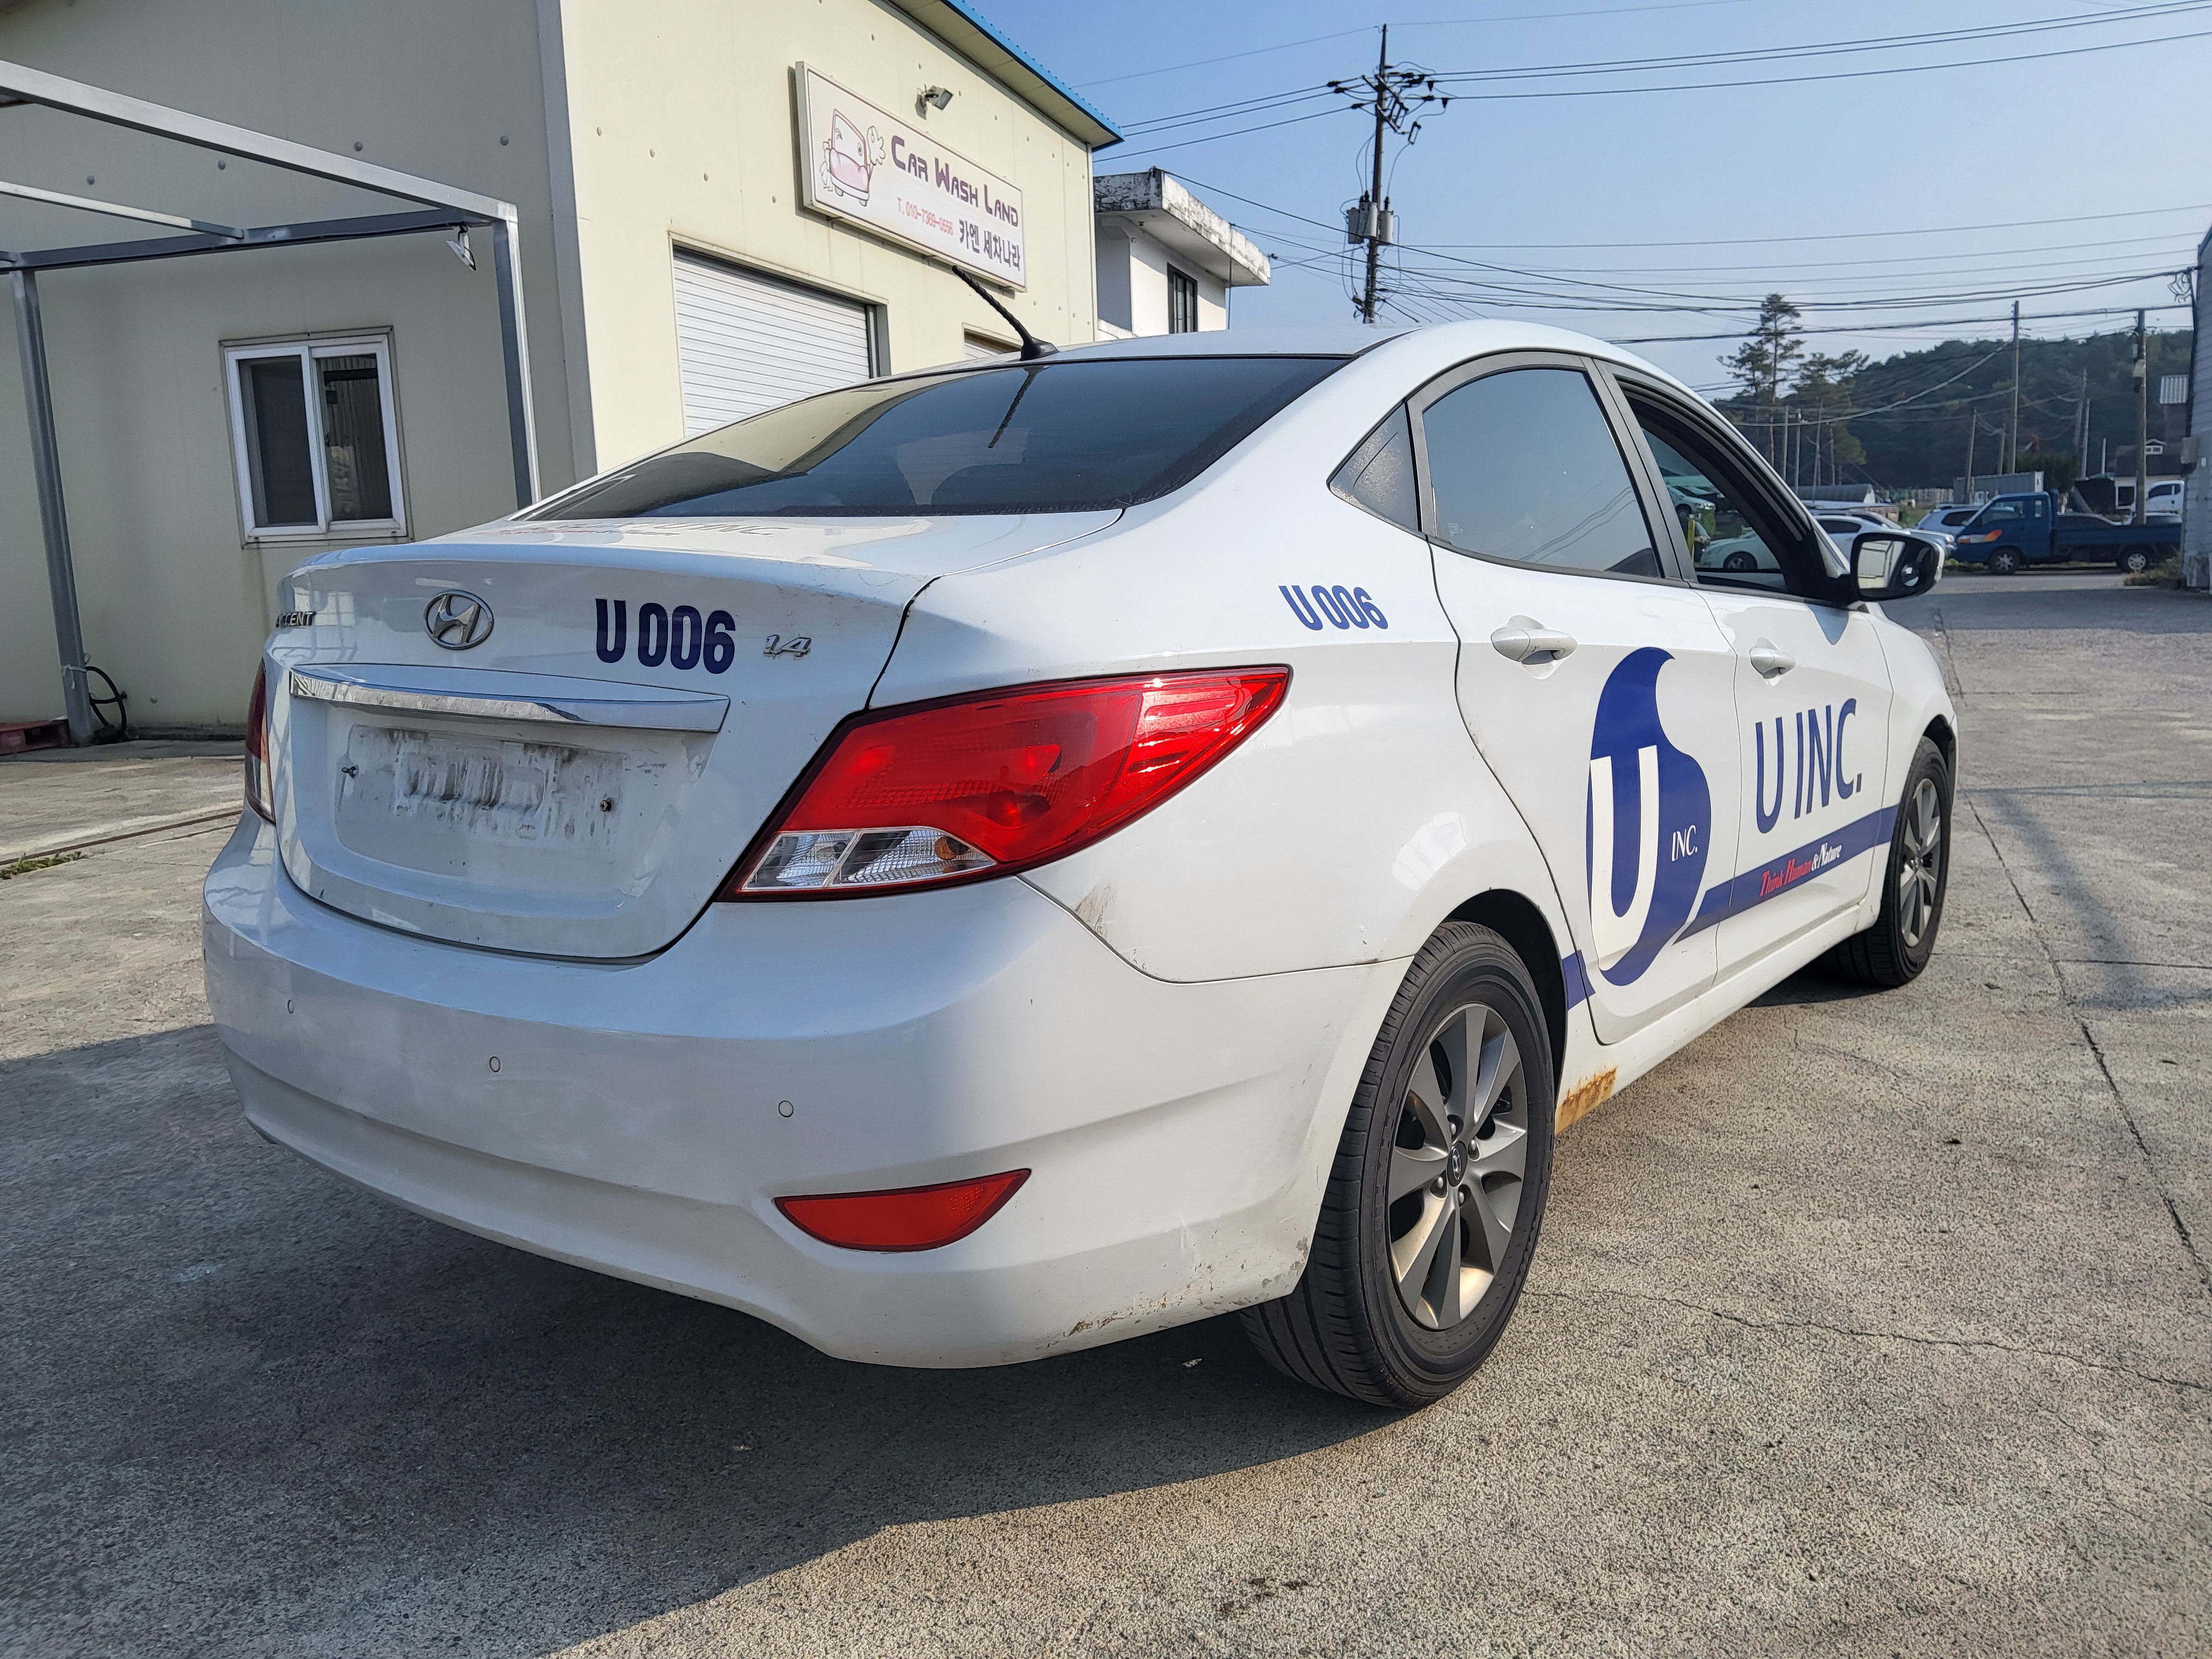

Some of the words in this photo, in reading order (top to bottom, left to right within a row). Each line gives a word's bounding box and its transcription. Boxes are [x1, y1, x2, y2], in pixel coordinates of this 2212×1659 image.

[595, 598, 627, 664] U
[637, 602, 736, 674] 006
[1278, 585, 1323, 631] U
[1311, 585, 1388, 630] 006
[1755, 716, 1784, 834] U
[1793, 698, 1863, 820] INC.
[1671, 824, 1698, 862] INC.
